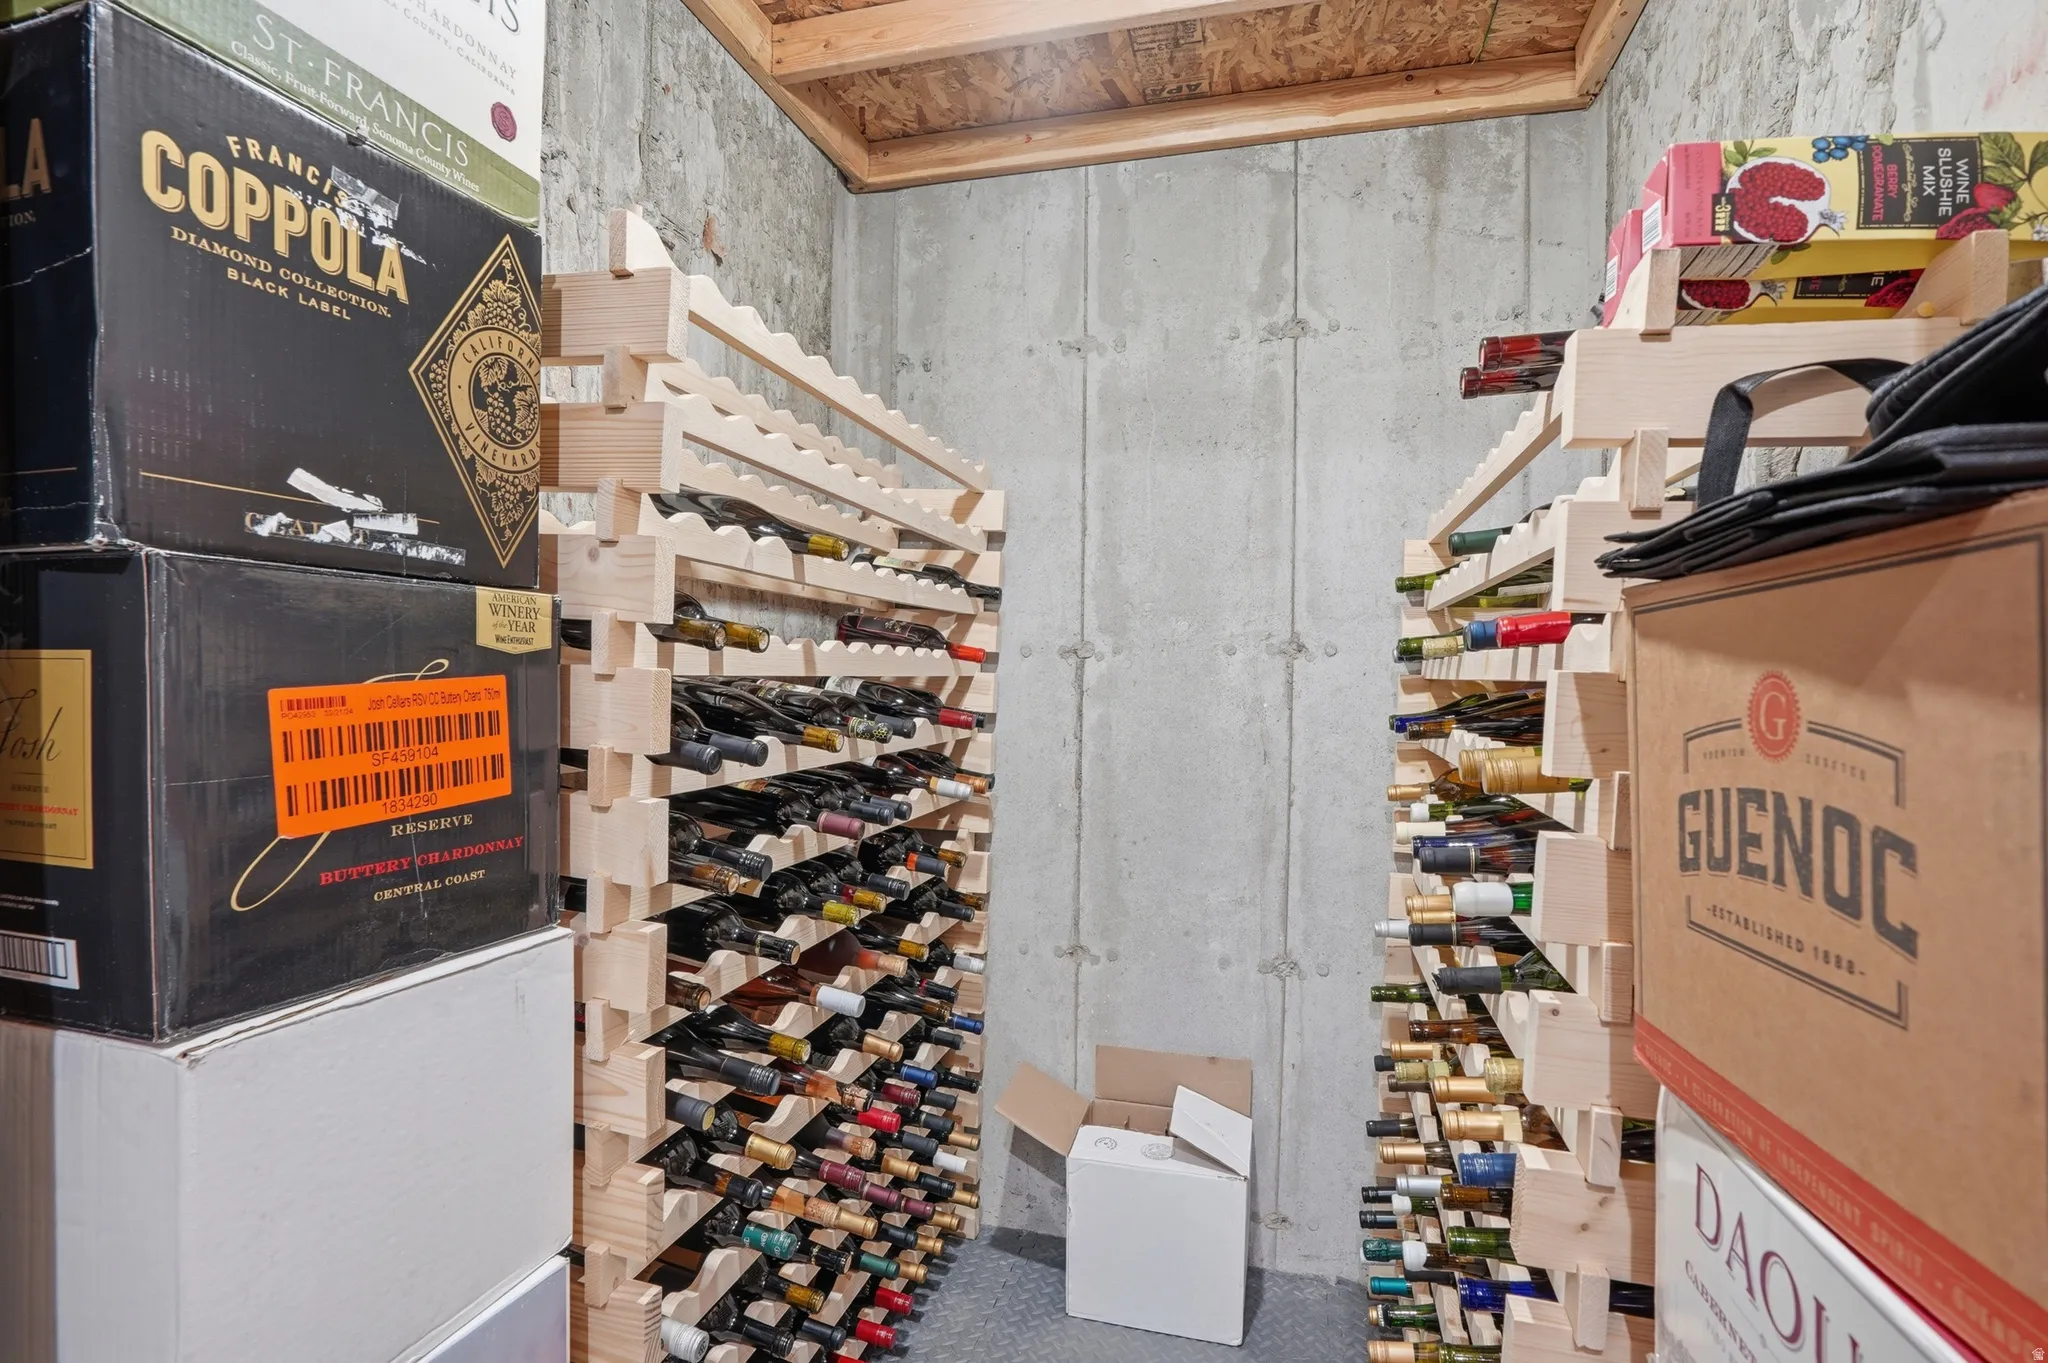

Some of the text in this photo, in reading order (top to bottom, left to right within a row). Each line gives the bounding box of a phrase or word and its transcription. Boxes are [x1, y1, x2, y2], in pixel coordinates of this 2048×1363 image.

[406, 0, 517, 79] HARDONNAY
[231, 41, 282, 80] Classic,
[372, 121, 414, 156] Sonoma
[416, 145, 451, 178] County
[451, 166, 480, 193] Wines
[323, 56, 468, 167] FRANCIS
[226, 135, 350, 208] FRANCIS
[1872, 145, 1885, 222] POMEGRANATE
[1887, 164, 1899, 199] BERRY
[1922, 165, 1936, 196] MIX
[1937, 147, 1953, 217] SLUSHIE
[1956, 158, 1970, 204] WINE
[141, 129, 409, 305] COPPOLA
[171, 226, 272, 274] DIAMOND
[227, 267, 351, 320] BLACK LABEL
[462, 335, 540, 384] CALIFORNI
[488, 602, 541, 620] WINERY
[491, 593, 537, 605] AMERICAN
[508, 620, 537, 633] YEAR
[1759, 691, 1787, 740] G
[372, 745, 439, 768] SF459104
[382, 792, 438, 815] 1834290
[391, 813, 473, 838] RESERVE
[319, 836, 524, 886] BUTTERY CHARDONNAY
[373, 869, 486, 902] CENTRAL COAST
[1678, 787, 1919, 965] GUENOC
